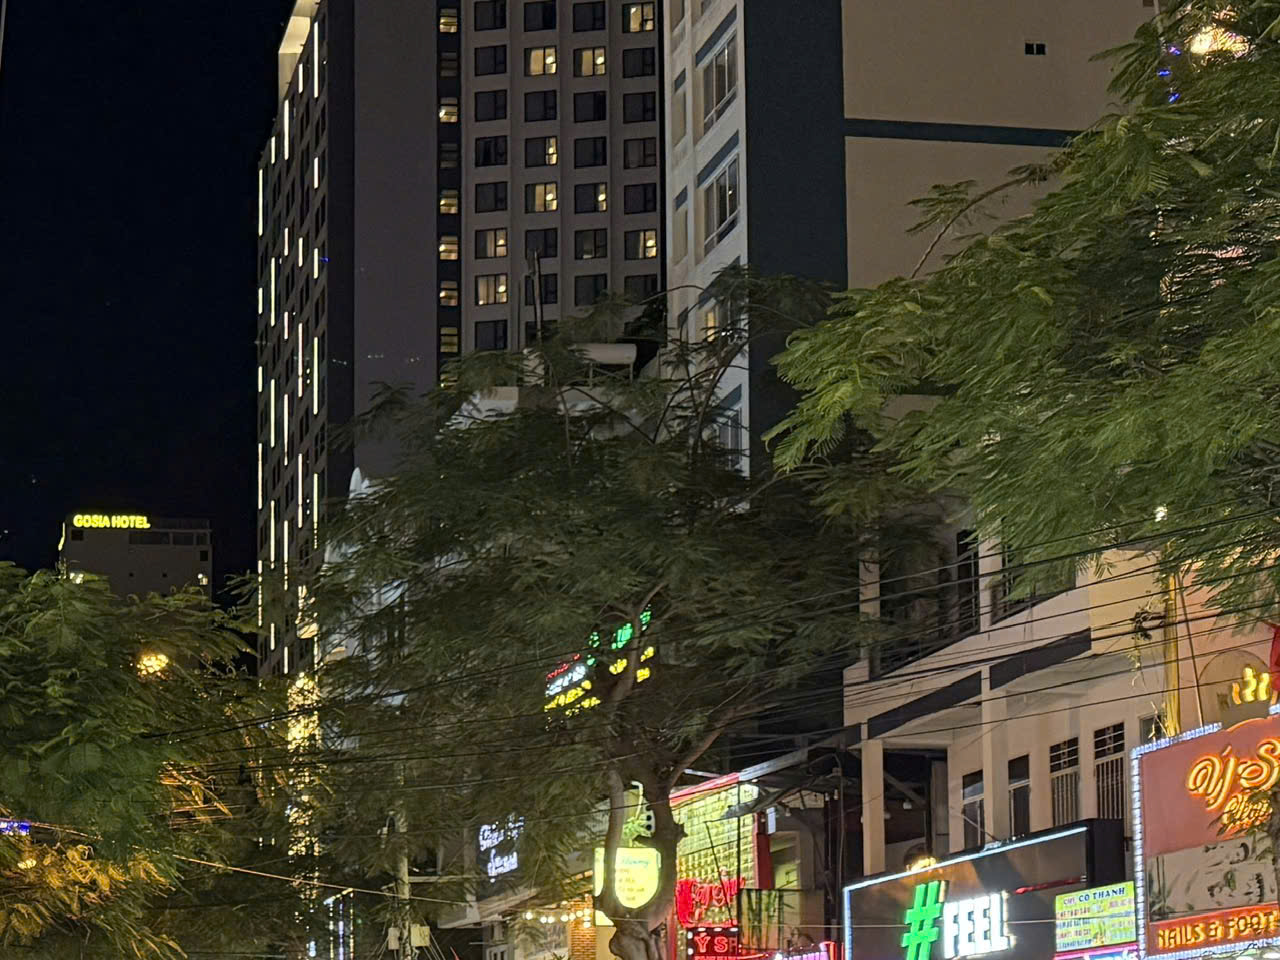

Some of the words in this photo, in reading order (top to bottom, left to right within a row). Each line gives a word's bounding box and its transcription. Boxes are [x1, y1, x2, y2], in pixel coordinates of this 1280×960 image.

[73, 514, 111, 528] GOSIA
[111, 515, 151, 528] HOTEL
[1092, 887, 1125, 900] THANH
[1158, 922, 1205, 949] NAILS
